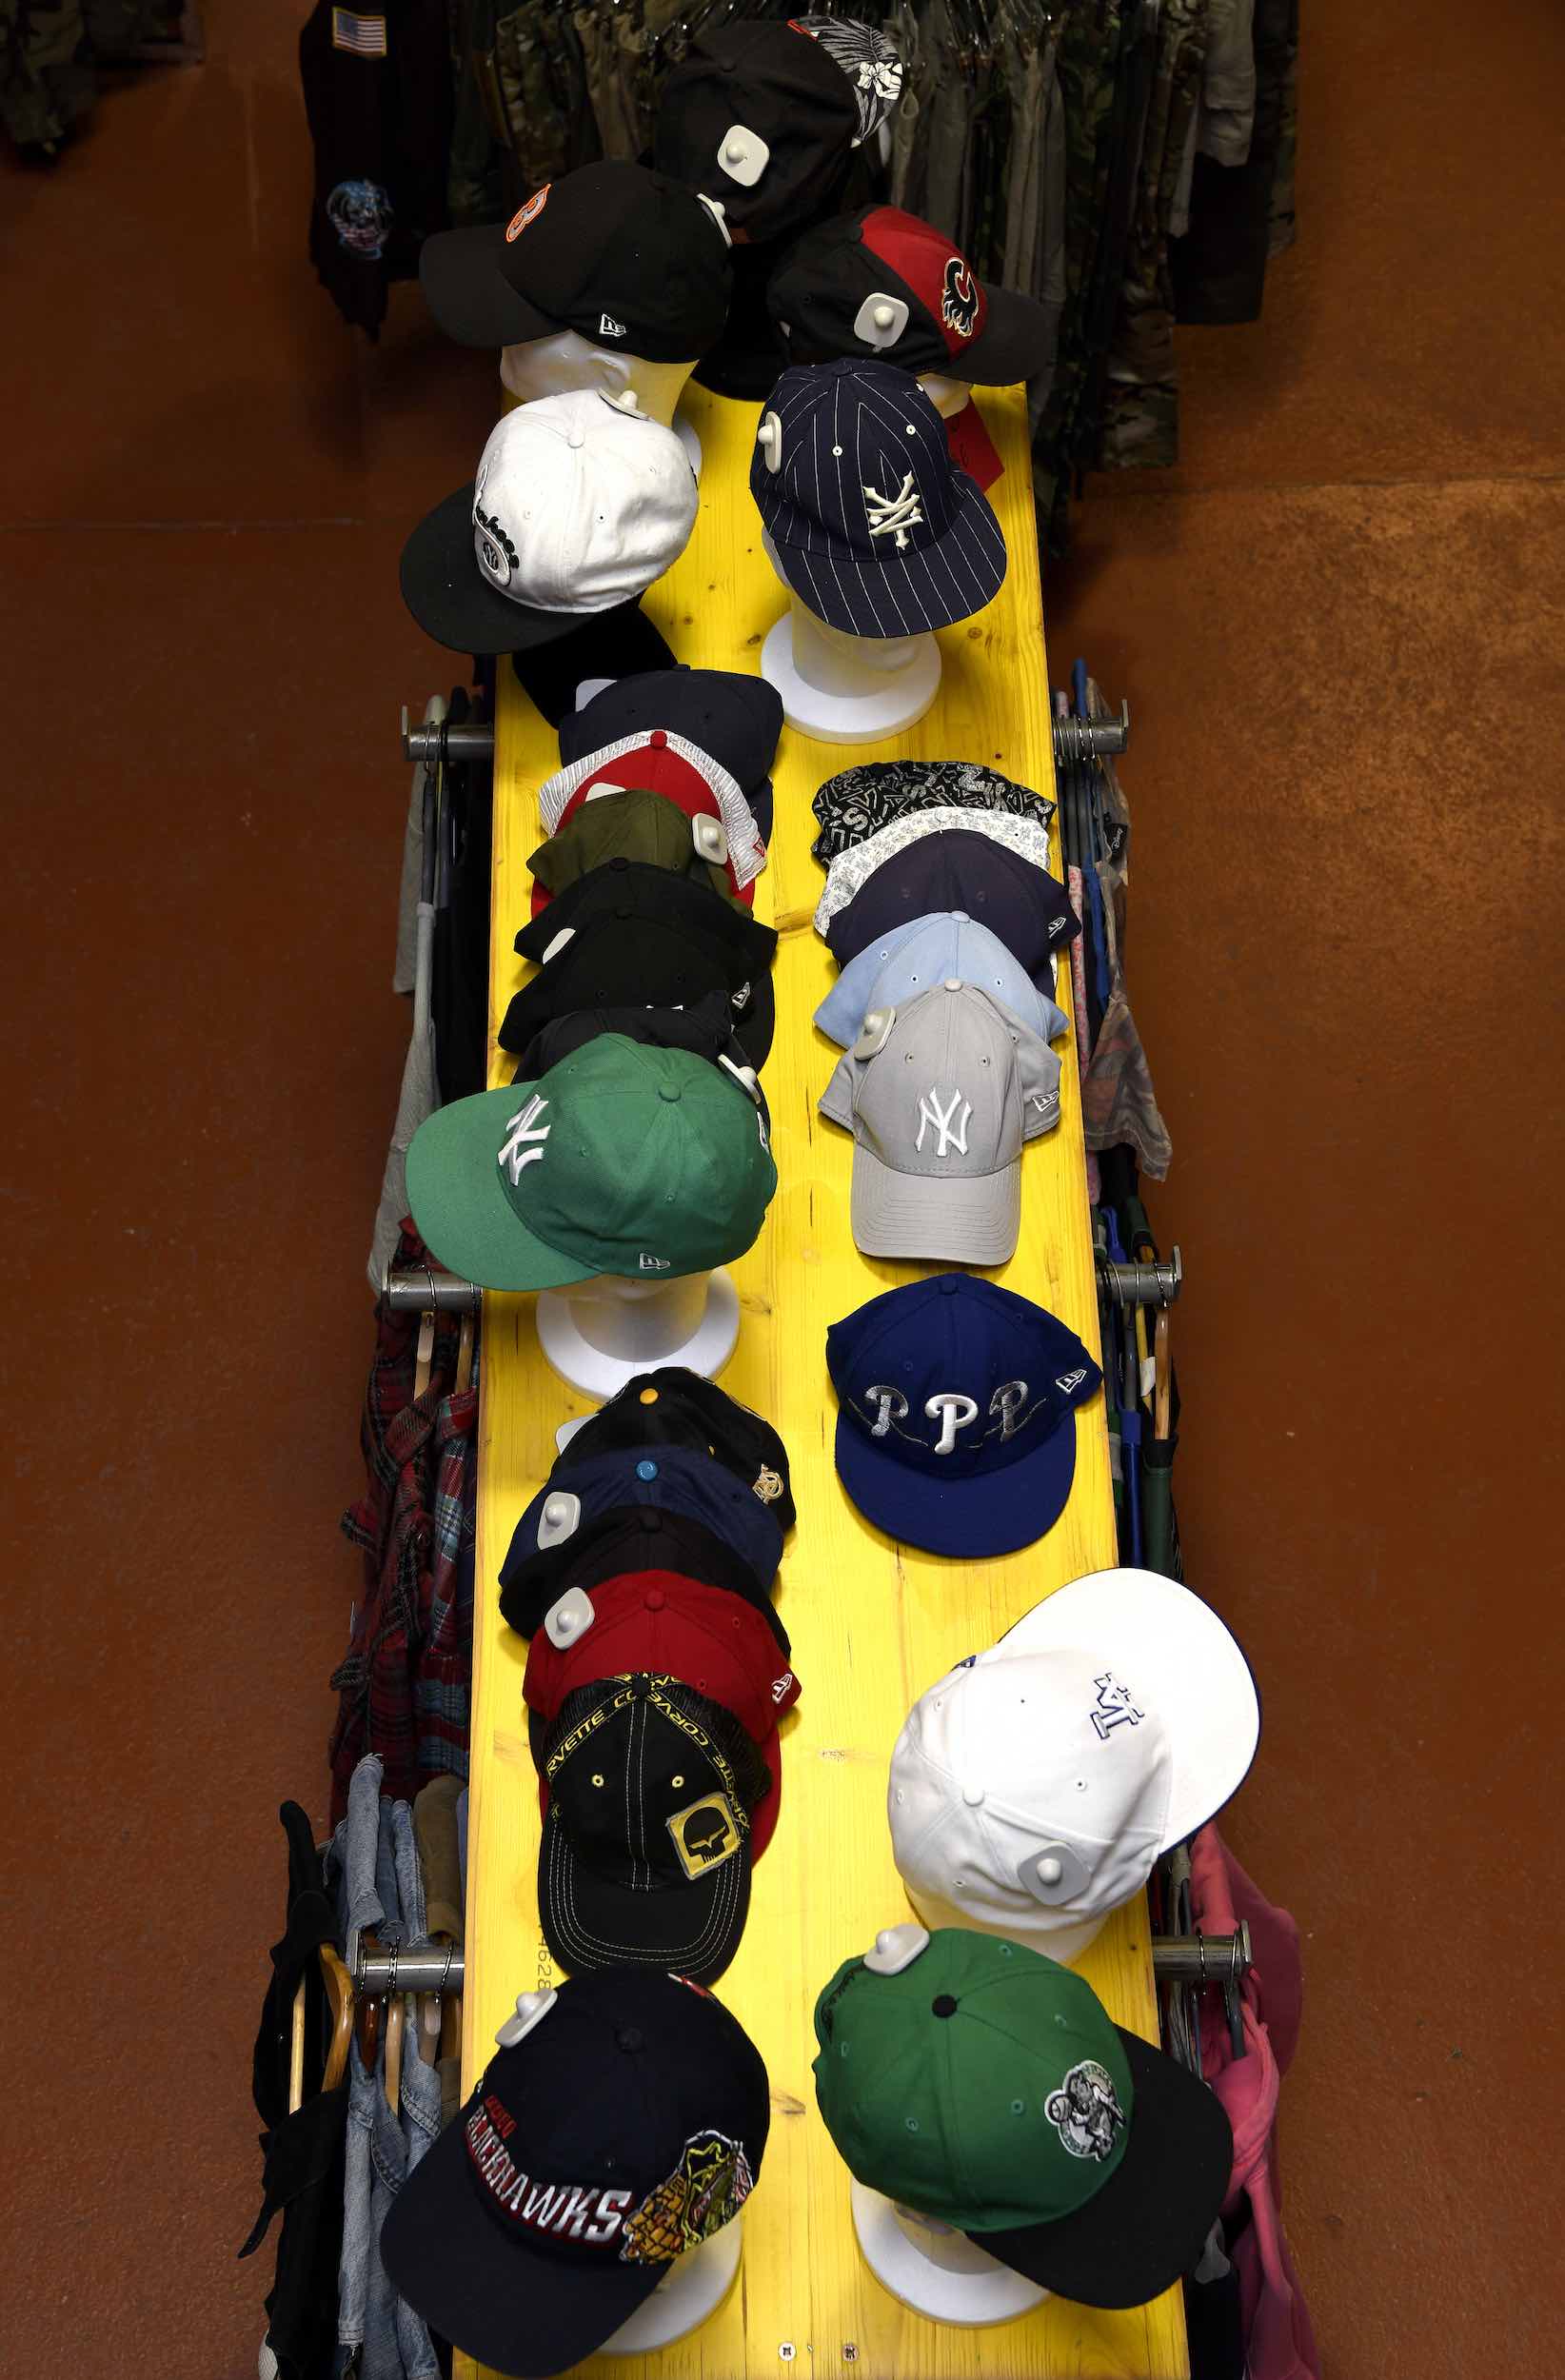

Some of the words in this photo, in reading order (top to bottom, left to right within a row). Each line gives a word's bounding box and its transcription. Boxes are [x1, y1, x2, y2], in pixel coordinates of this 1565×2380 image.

[498, 1094, 551, 1187] NY
[915, 1087, 972, 1157] NY
[925, 1394, 979, 1456] P
[466, 2104, 632, 2241] BLACKHAWKS
